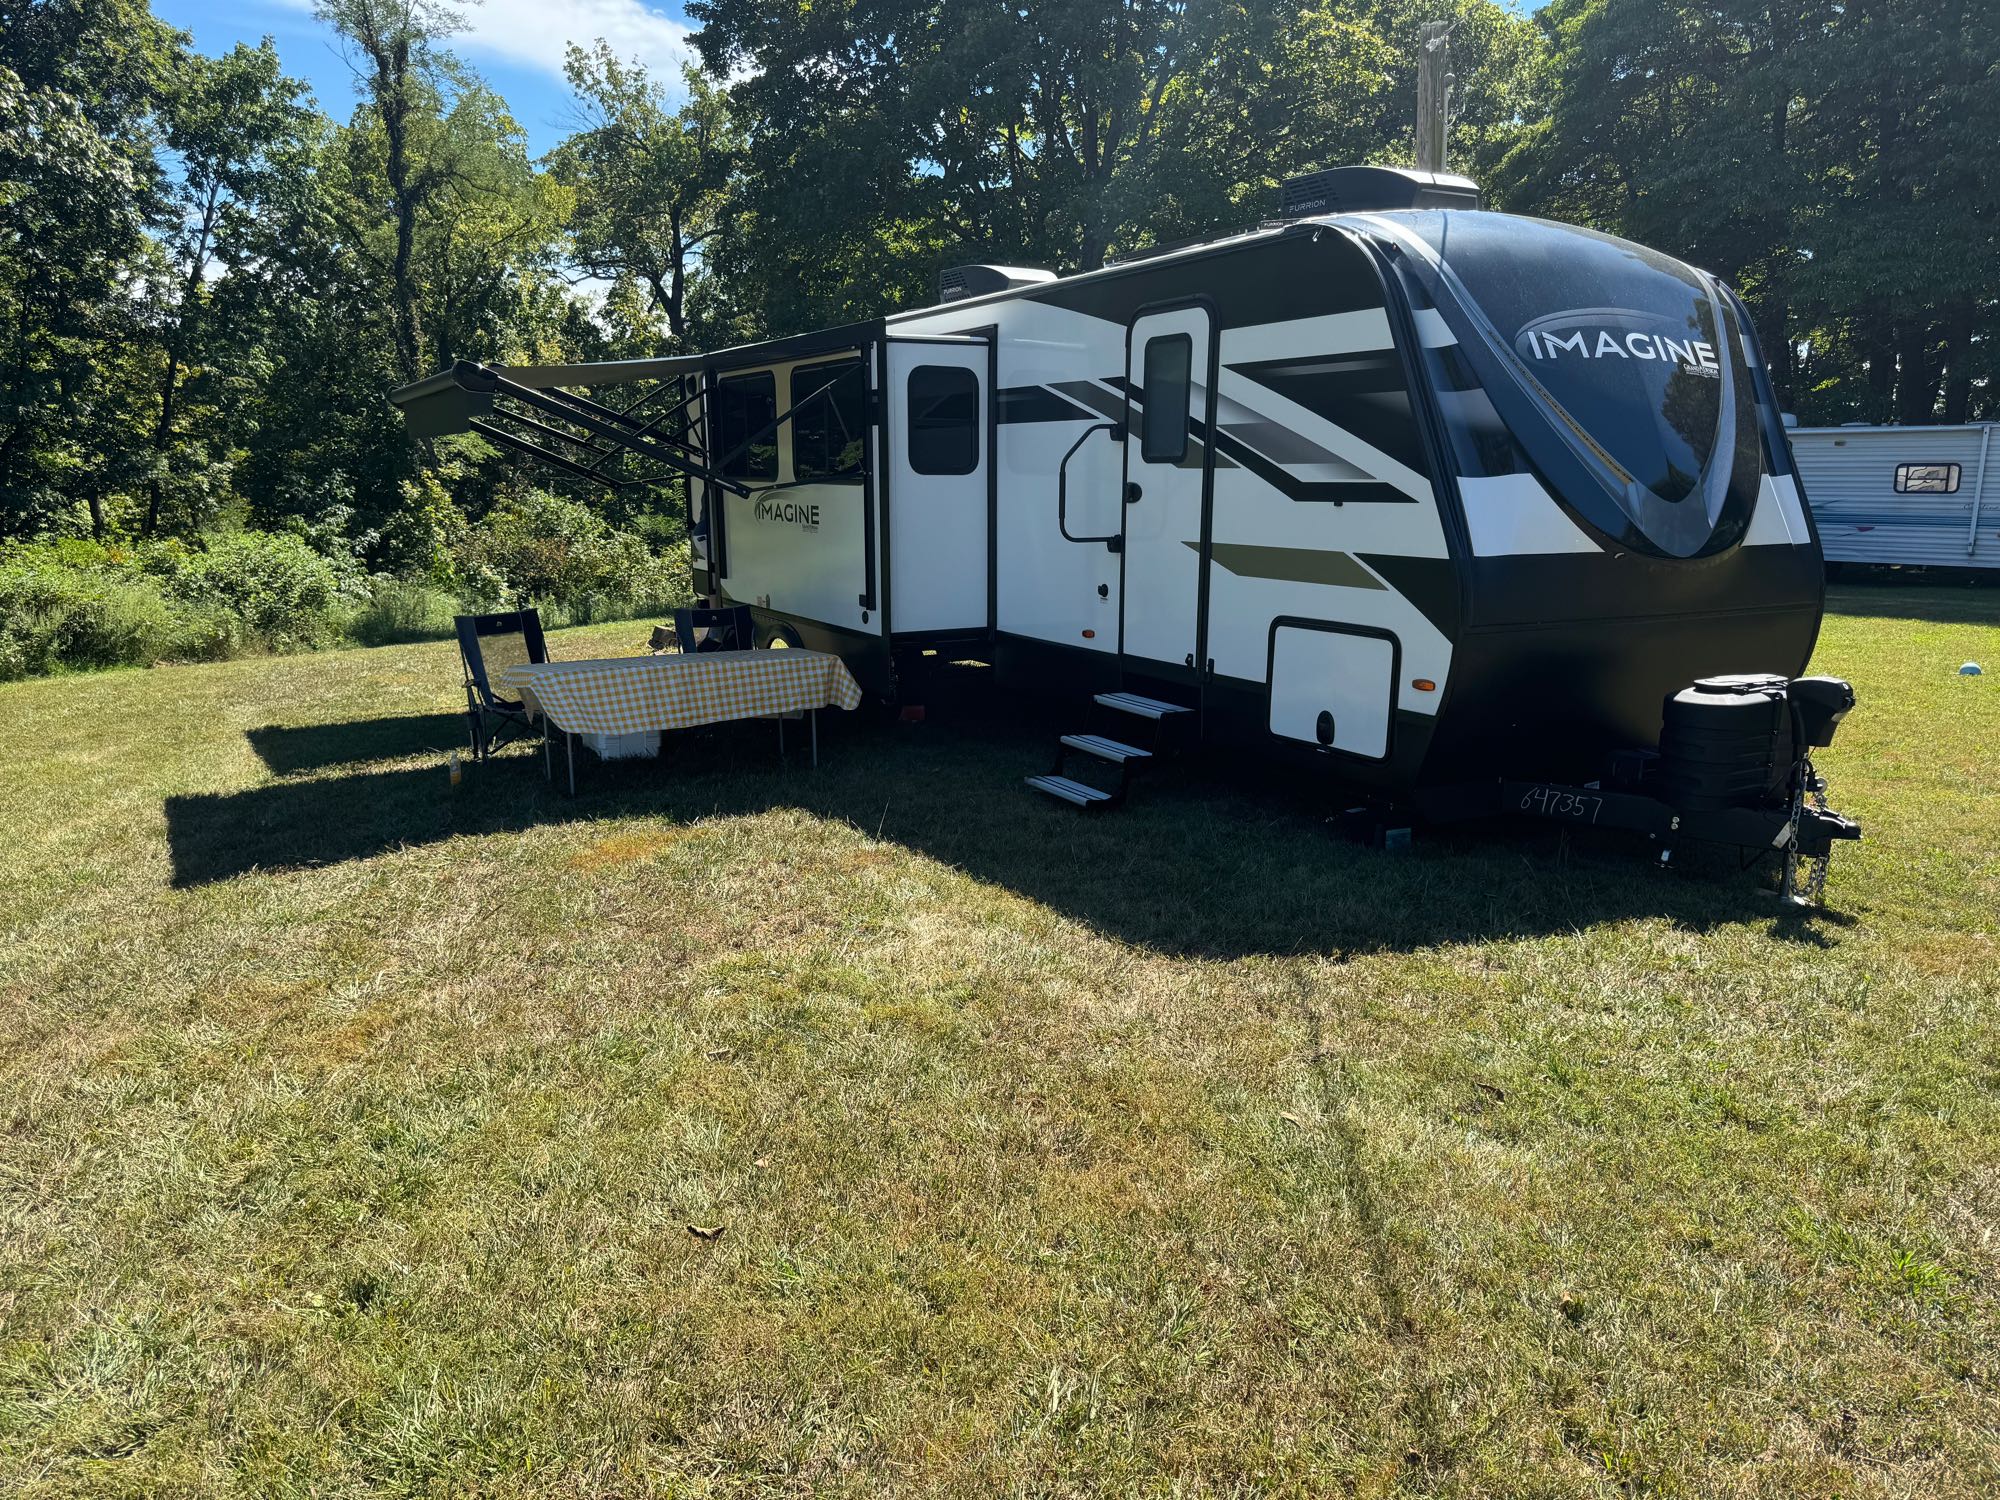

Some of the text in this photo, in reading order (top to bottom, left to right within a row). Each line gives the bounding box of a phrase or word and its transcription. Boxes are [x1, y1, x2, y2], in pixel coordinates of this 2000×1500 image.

[1289, 199, 1326, 213] FURRION
[1527, 330, 1720, 369] IMAGINE
[757, 501, 820, 525] IMAGINE
[1520, 787, 1603, 825] 647357
